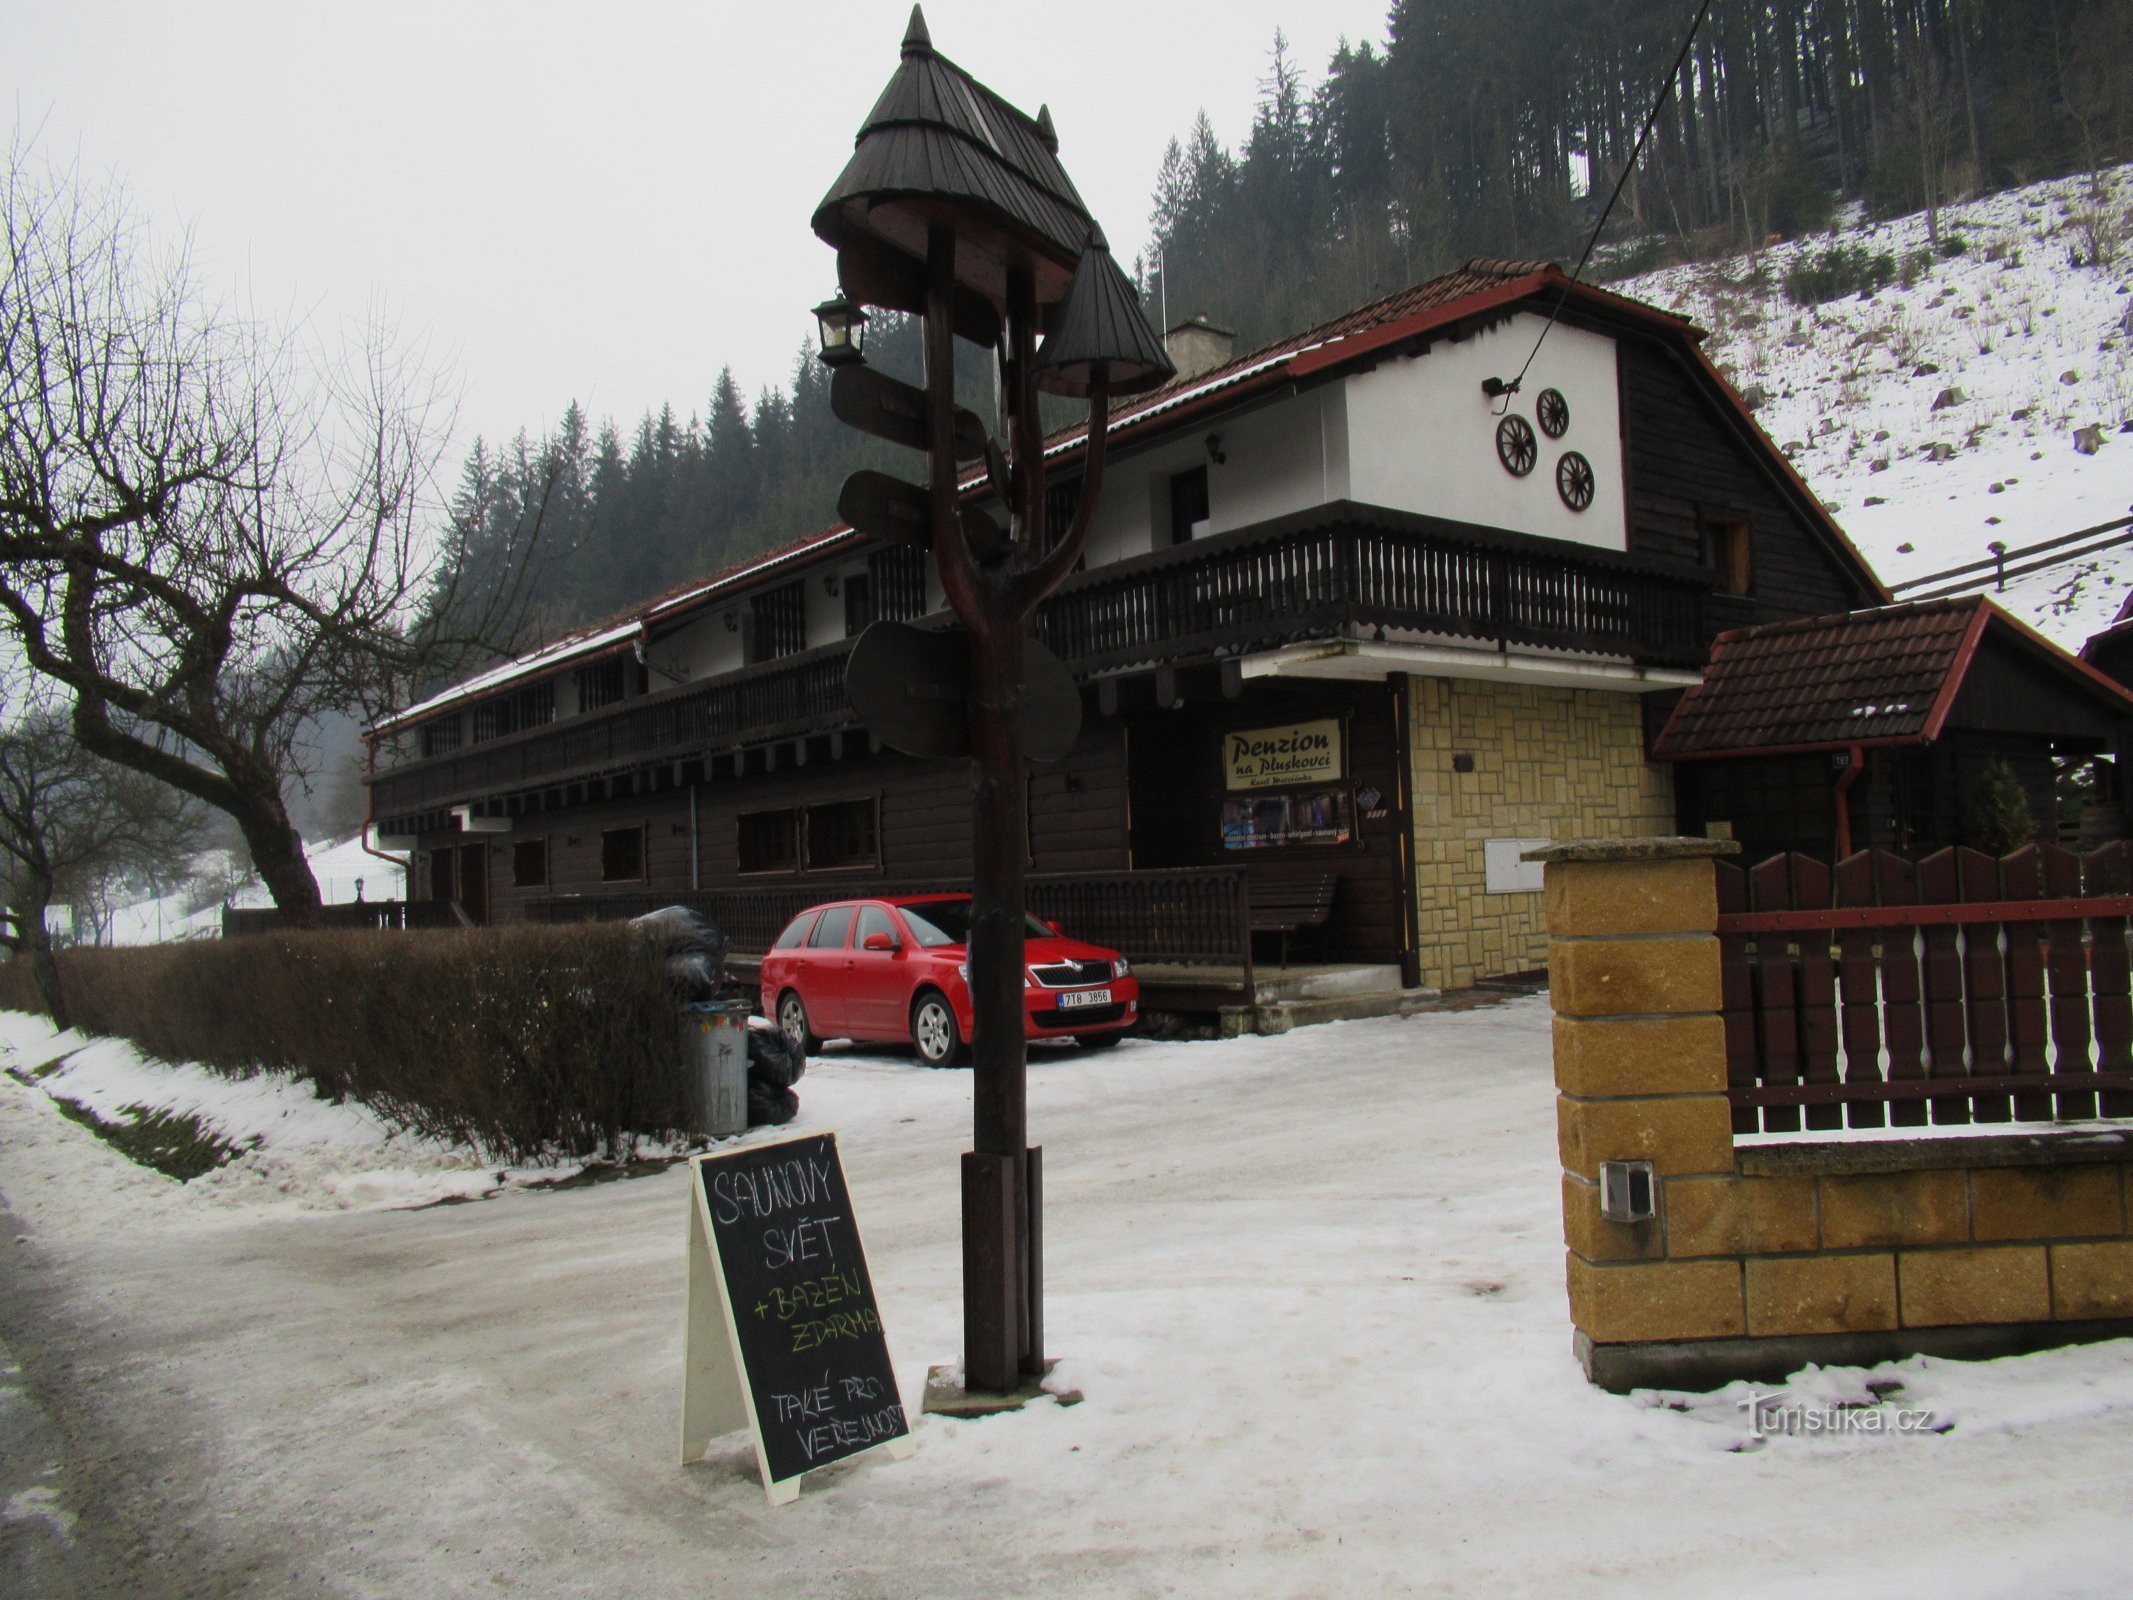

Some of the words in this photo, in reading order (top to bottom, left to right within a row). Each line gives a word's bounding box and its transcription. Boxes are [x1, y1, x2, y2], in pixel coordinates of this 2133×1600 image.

[1232, 730, 1328, 764] Penzion
[1236, 764, 1253, 775] na
[1260, 752, 1331, 775] Pluskovci
[1065, 994, 1083, 1006] 7T8
[1088, 991, 1108, 1003] 3856
[715, 1142, 832, 1224] SAUNOVÝ
[763, 1216, 840, 1269] SVĚT
[791, 1307, 881, 1352] ZDARMA
[771, 1368, 836, 1423] TAKÉ
[839, 1376, 884, 1402] PRO
